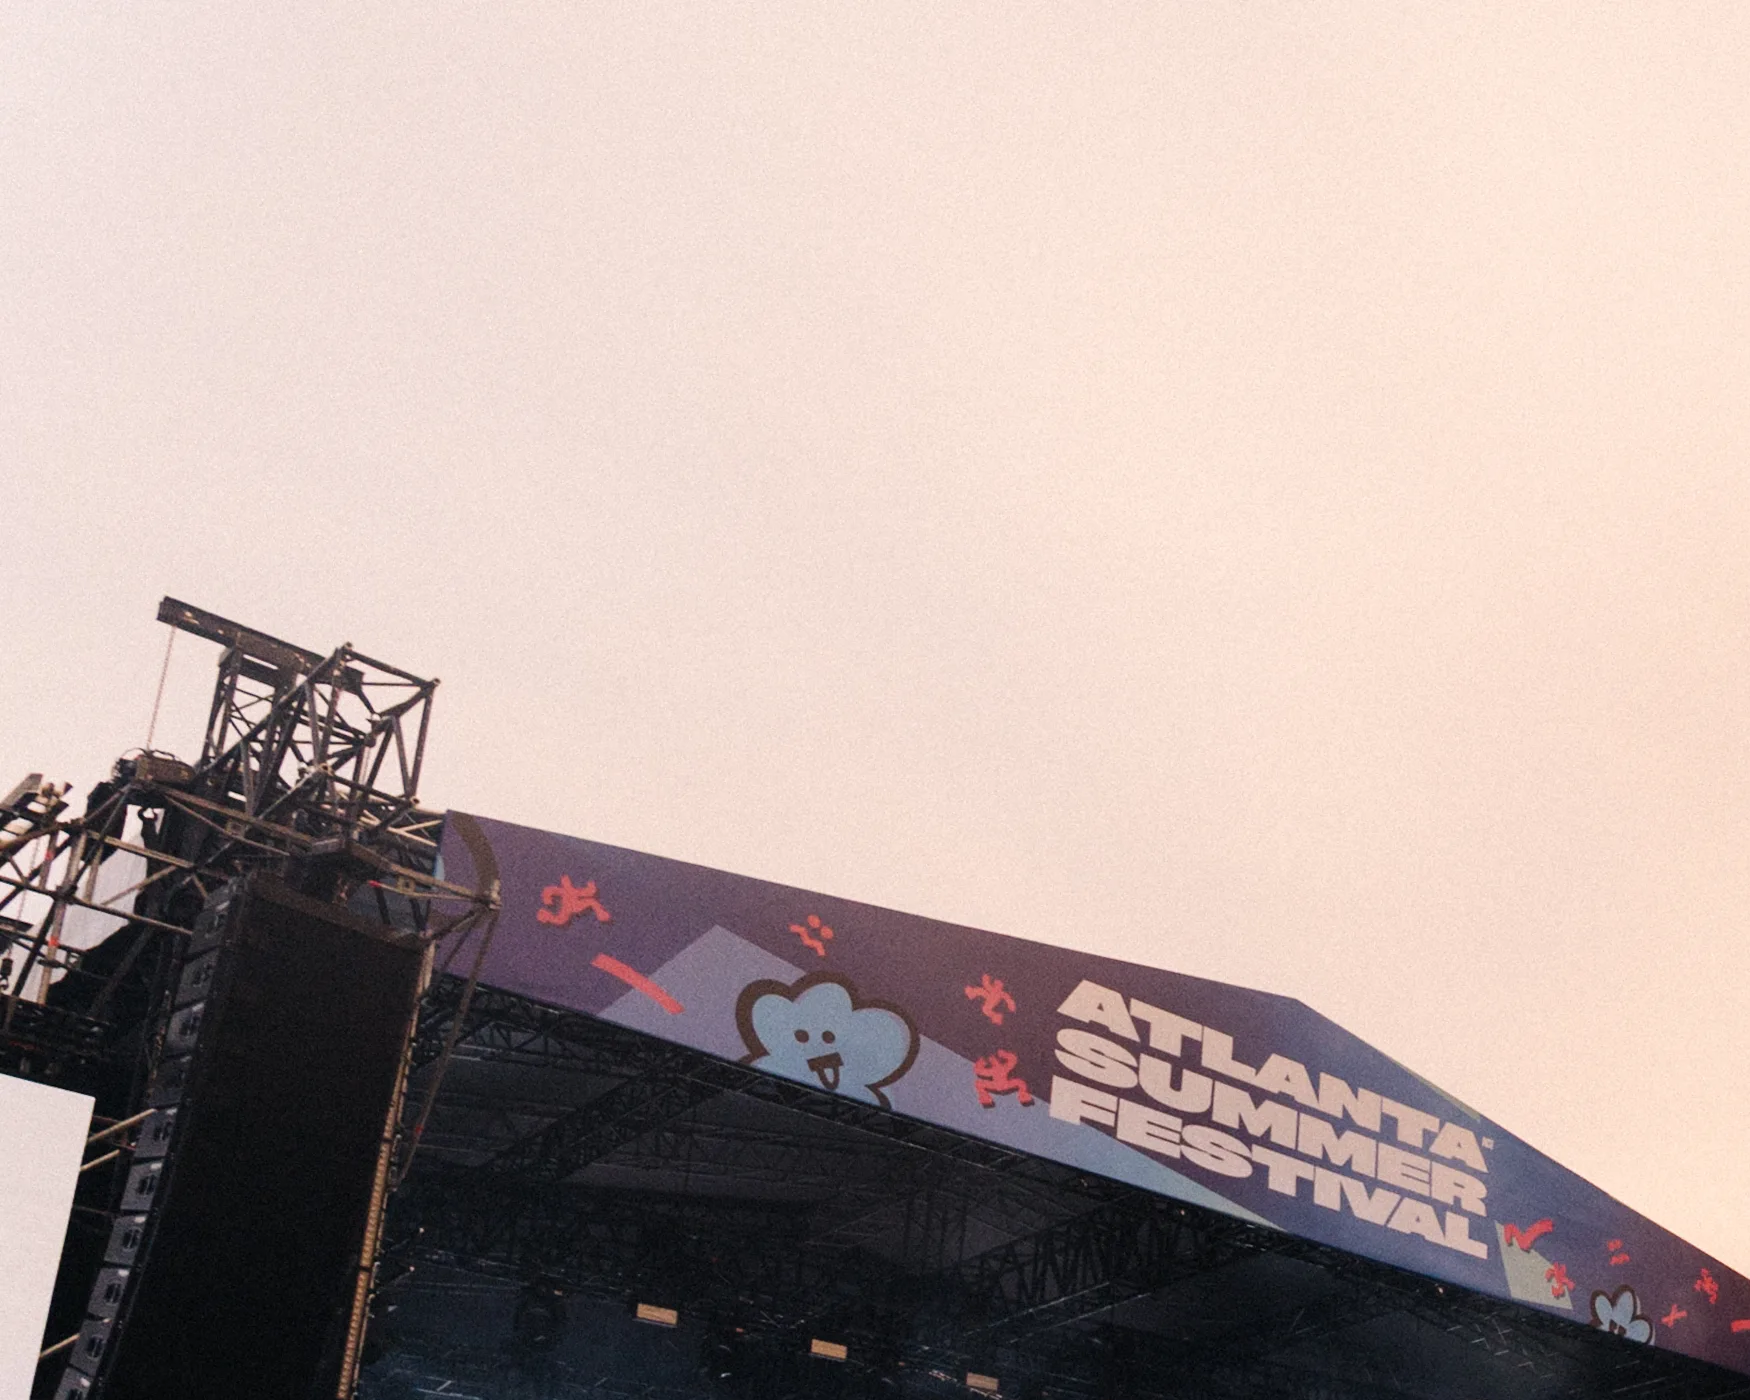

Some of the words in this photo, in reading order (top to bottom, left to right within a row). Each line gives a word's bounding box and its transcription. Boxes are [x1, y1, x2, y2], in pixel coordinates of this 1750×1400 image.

[1049, 1075, 1488, 1260] FESTIVAL
[1054, 1028, 1487, 1217] SUMMER
[1056, 979, 1489, 1172] ATLANTA
